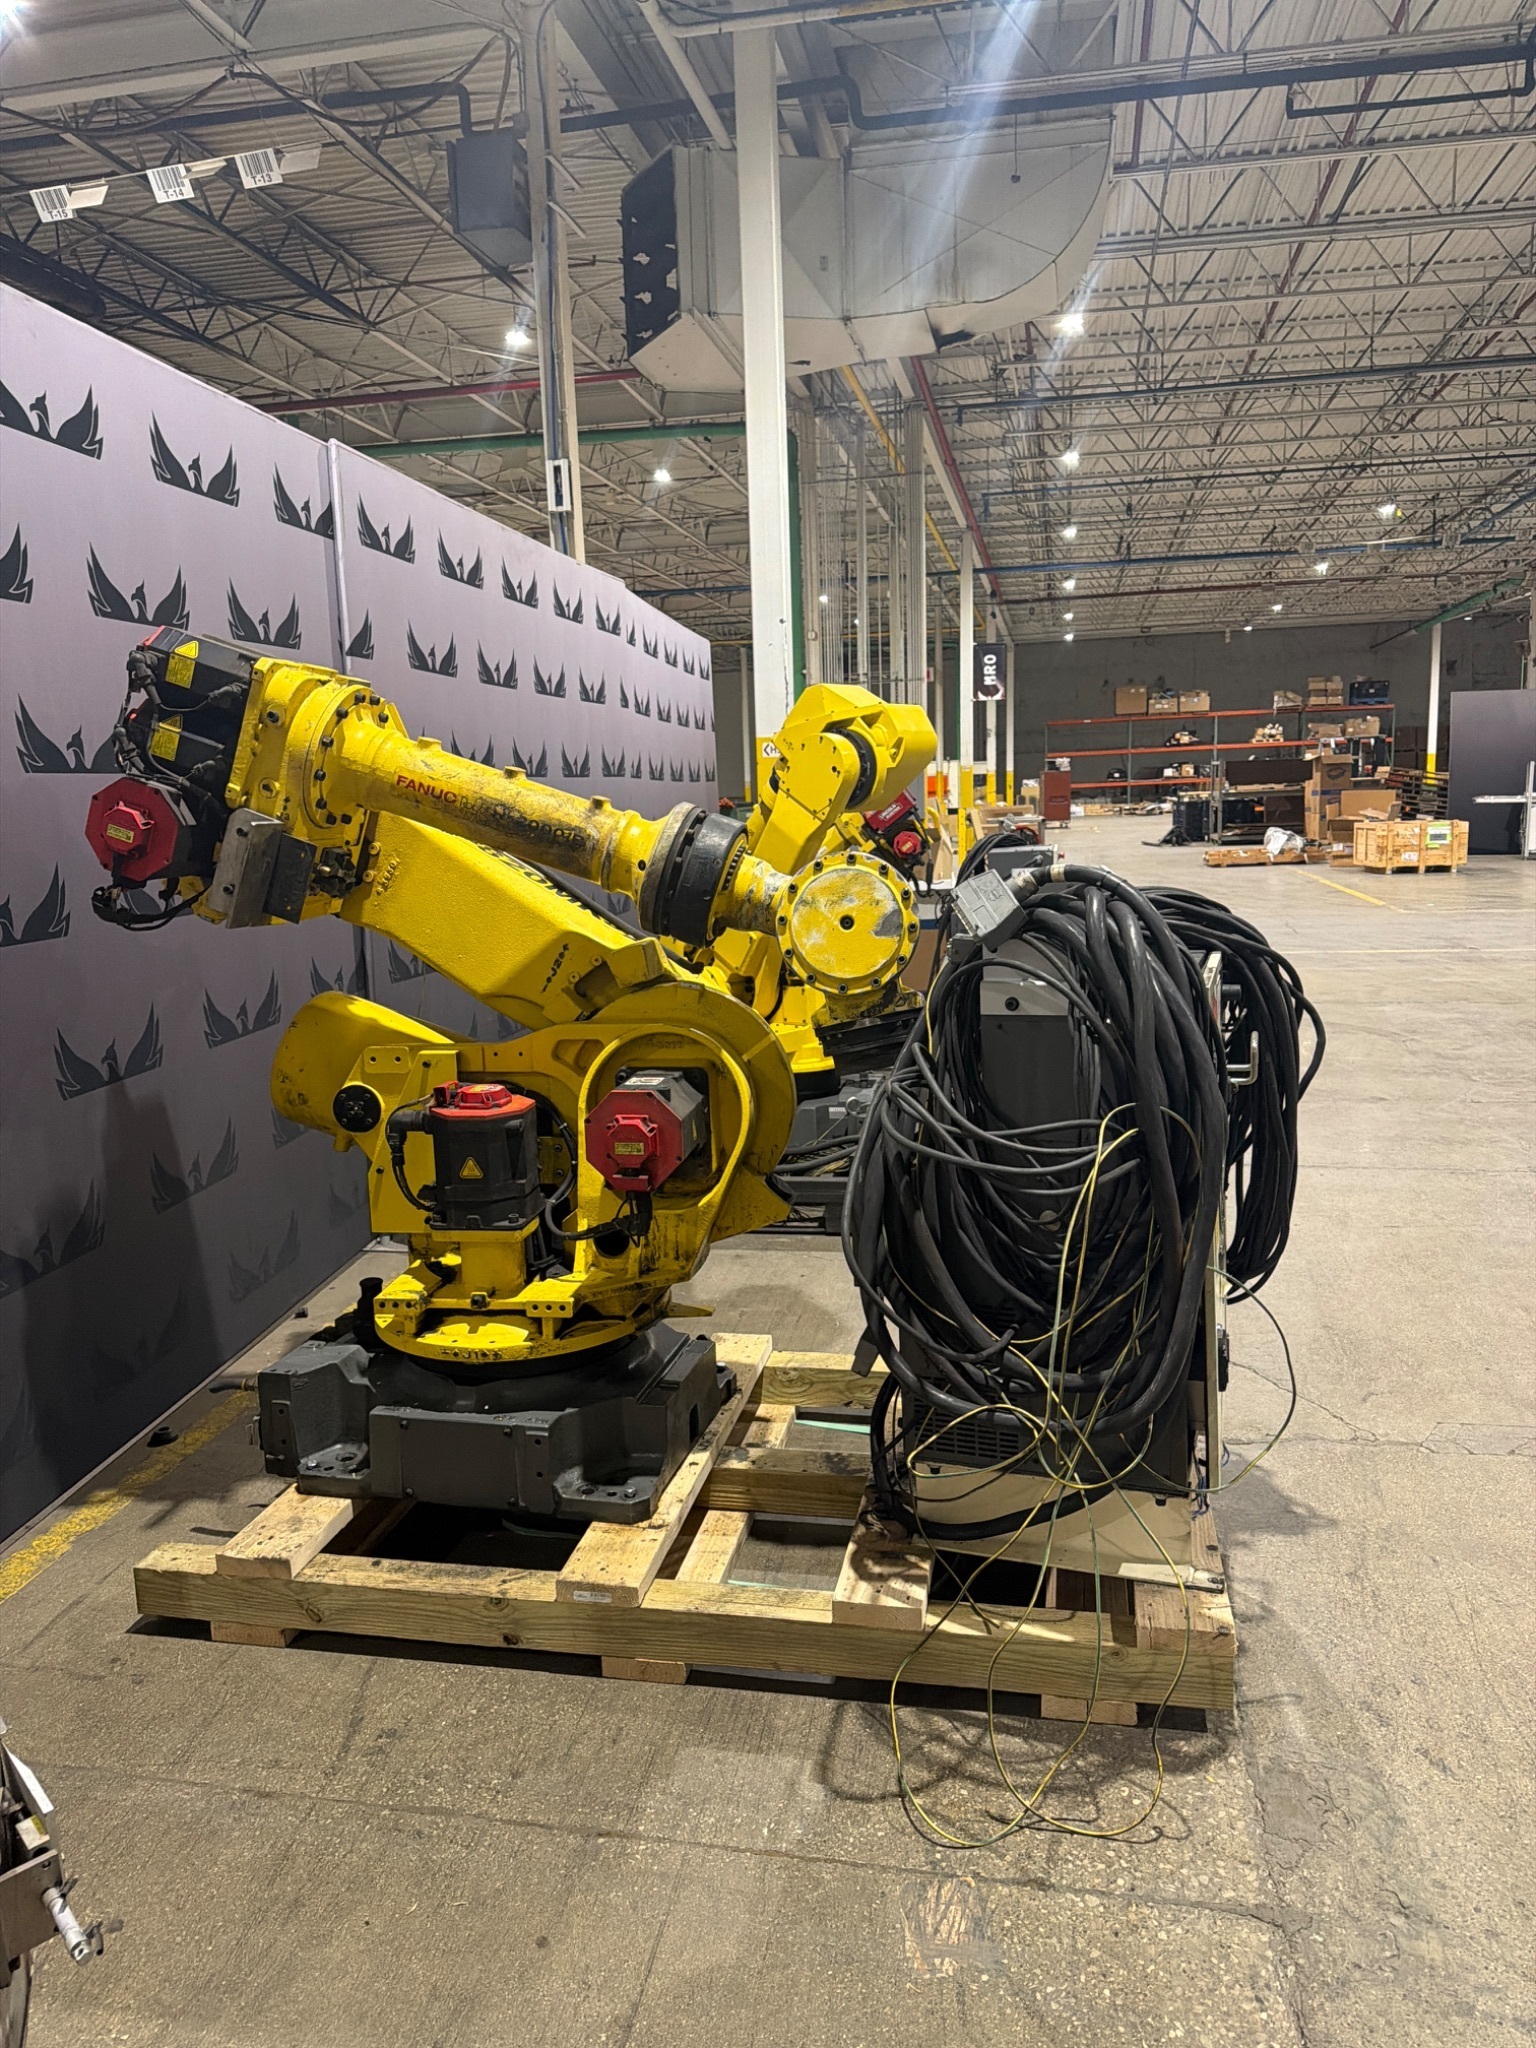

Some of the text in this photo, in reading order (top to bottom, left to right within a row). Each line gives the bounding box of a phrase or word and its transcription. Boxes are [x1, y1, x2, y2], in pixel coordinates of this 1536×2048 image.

[250, 173, 273, 186] T-13
[163, 189, 185, 199] T-14
[47, 209, 68, 219] T-15
[983, 654, 997, 686] MRO
[395, 774, 457, 803] FANUC
